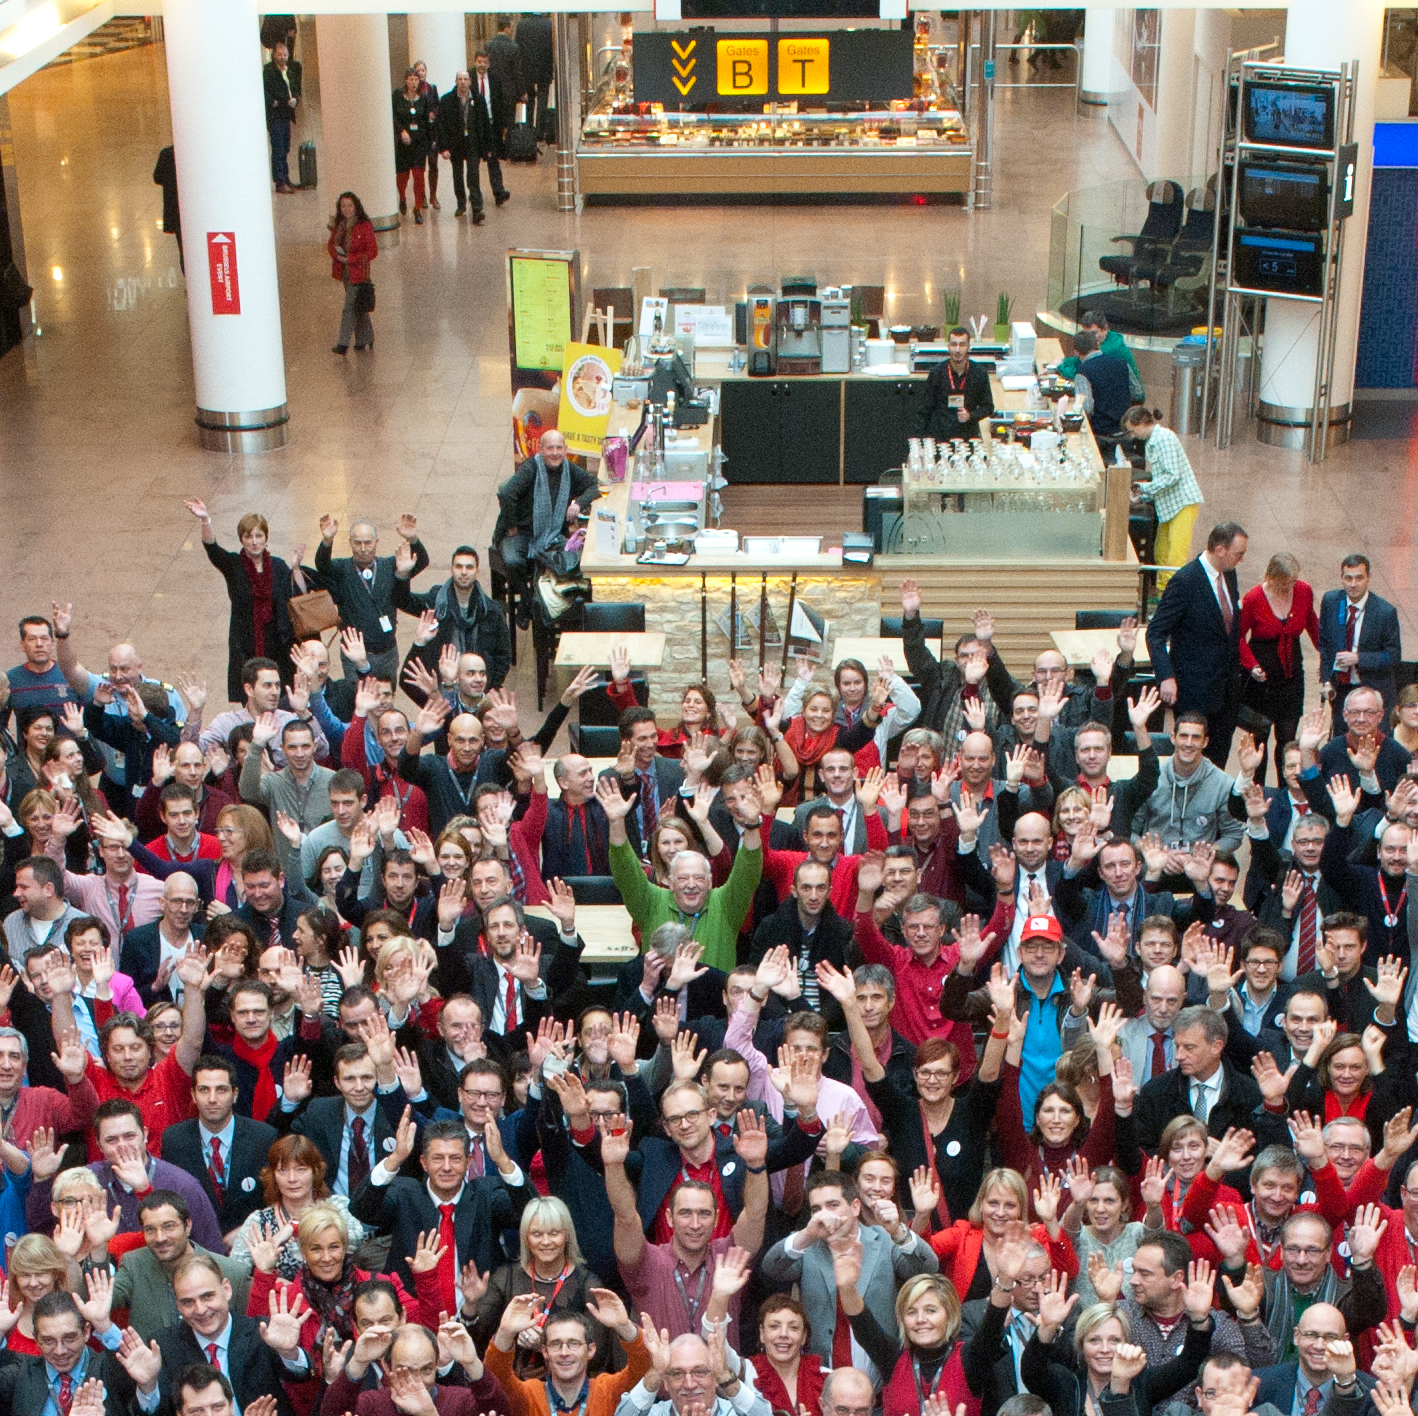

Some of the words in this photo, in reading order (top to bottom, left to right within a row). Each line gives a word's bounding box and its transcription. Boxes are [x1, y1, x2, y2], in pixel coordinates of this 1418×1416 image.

[726, 45, 759, 56] Gates
[787, 44, 820, 55] Gates
[732, 60, 753, 88] B
[793, 60, 814, 88] T
